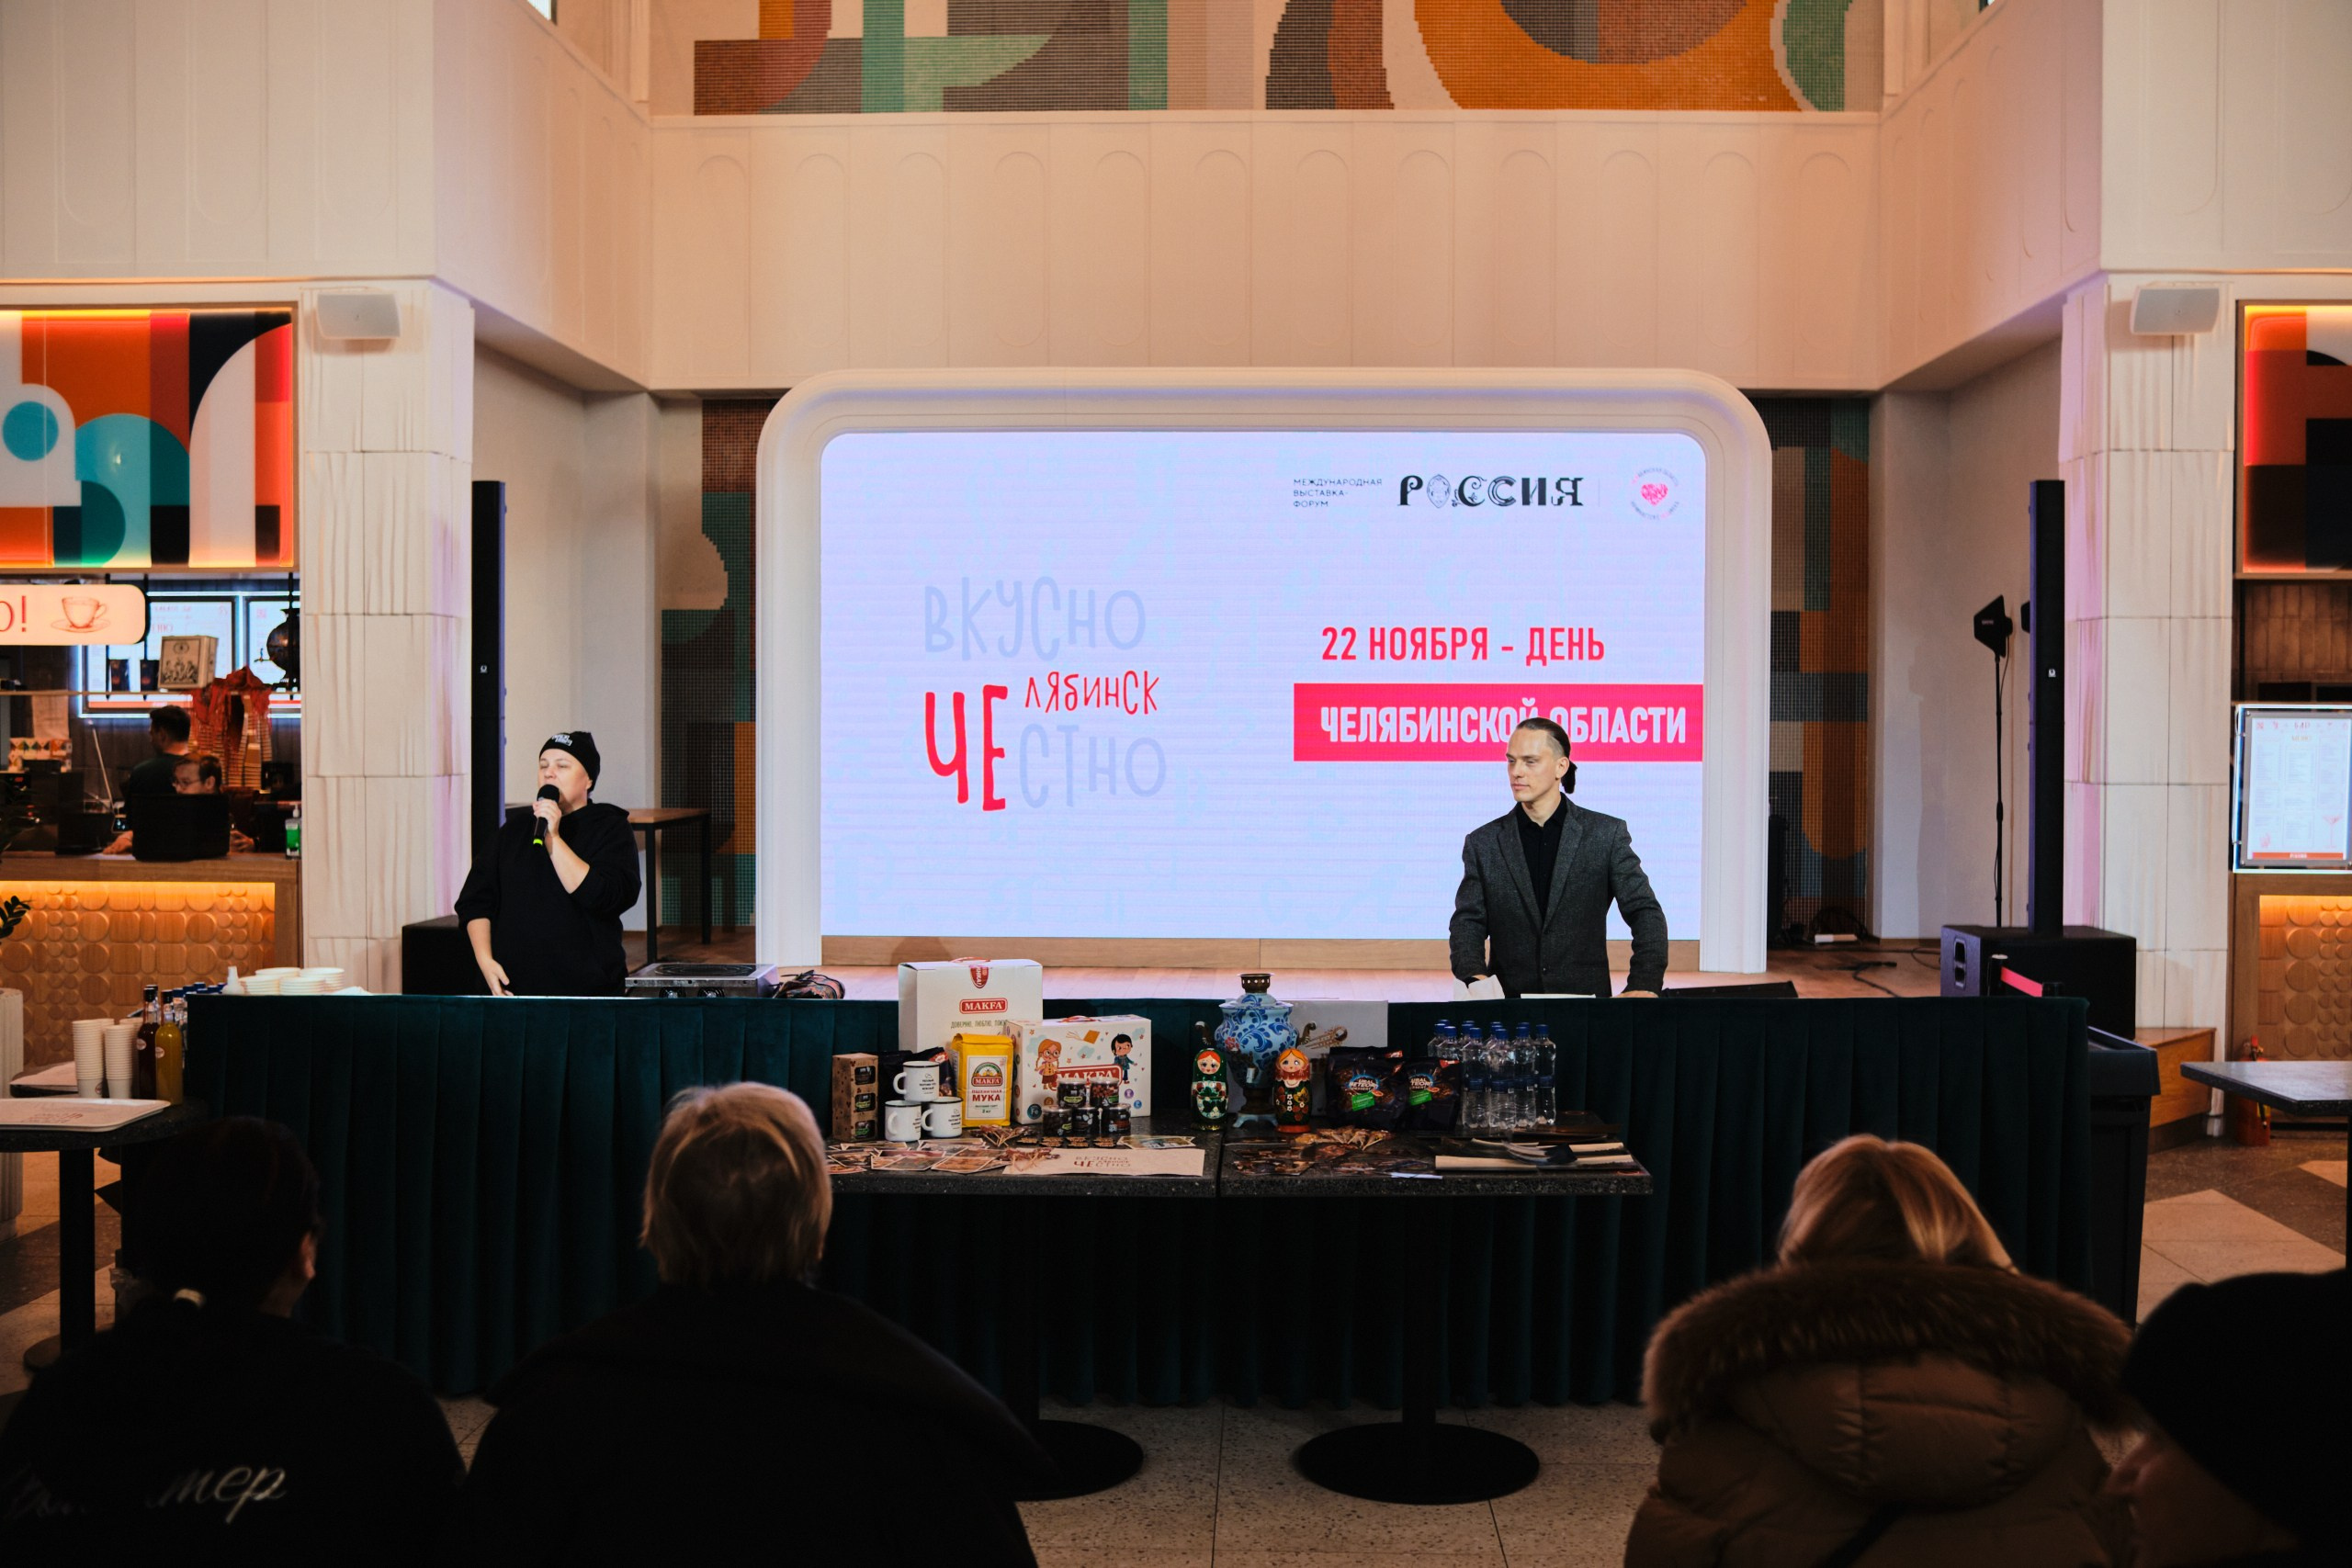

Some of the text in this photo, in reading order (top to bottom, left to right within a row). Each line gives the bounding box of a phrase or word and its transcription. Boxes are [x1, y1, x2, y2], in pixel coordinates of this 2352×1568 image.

[1293, 489, 1349, 497] ВЫСТАВКА-
[1294, 478, 1383, 487] МЕЖДУНАРОДНАЯ
[1397, 474, 1584, 509] РОССИЯ
[1293, 500, 1329, 508] ФОРУМ
[924, 576, 1147, 661] ВКУСНО
[1321, 626, 1357, 660] 22
[1369, 626, 1488, 660] НОЯБРЯ
[1525, 626, 1605, 667] ДЕНЬ
[1550, 706, 1687, 743] ОБЛАСТИ
[965, 1001, 1003, 1011] MAKFA
